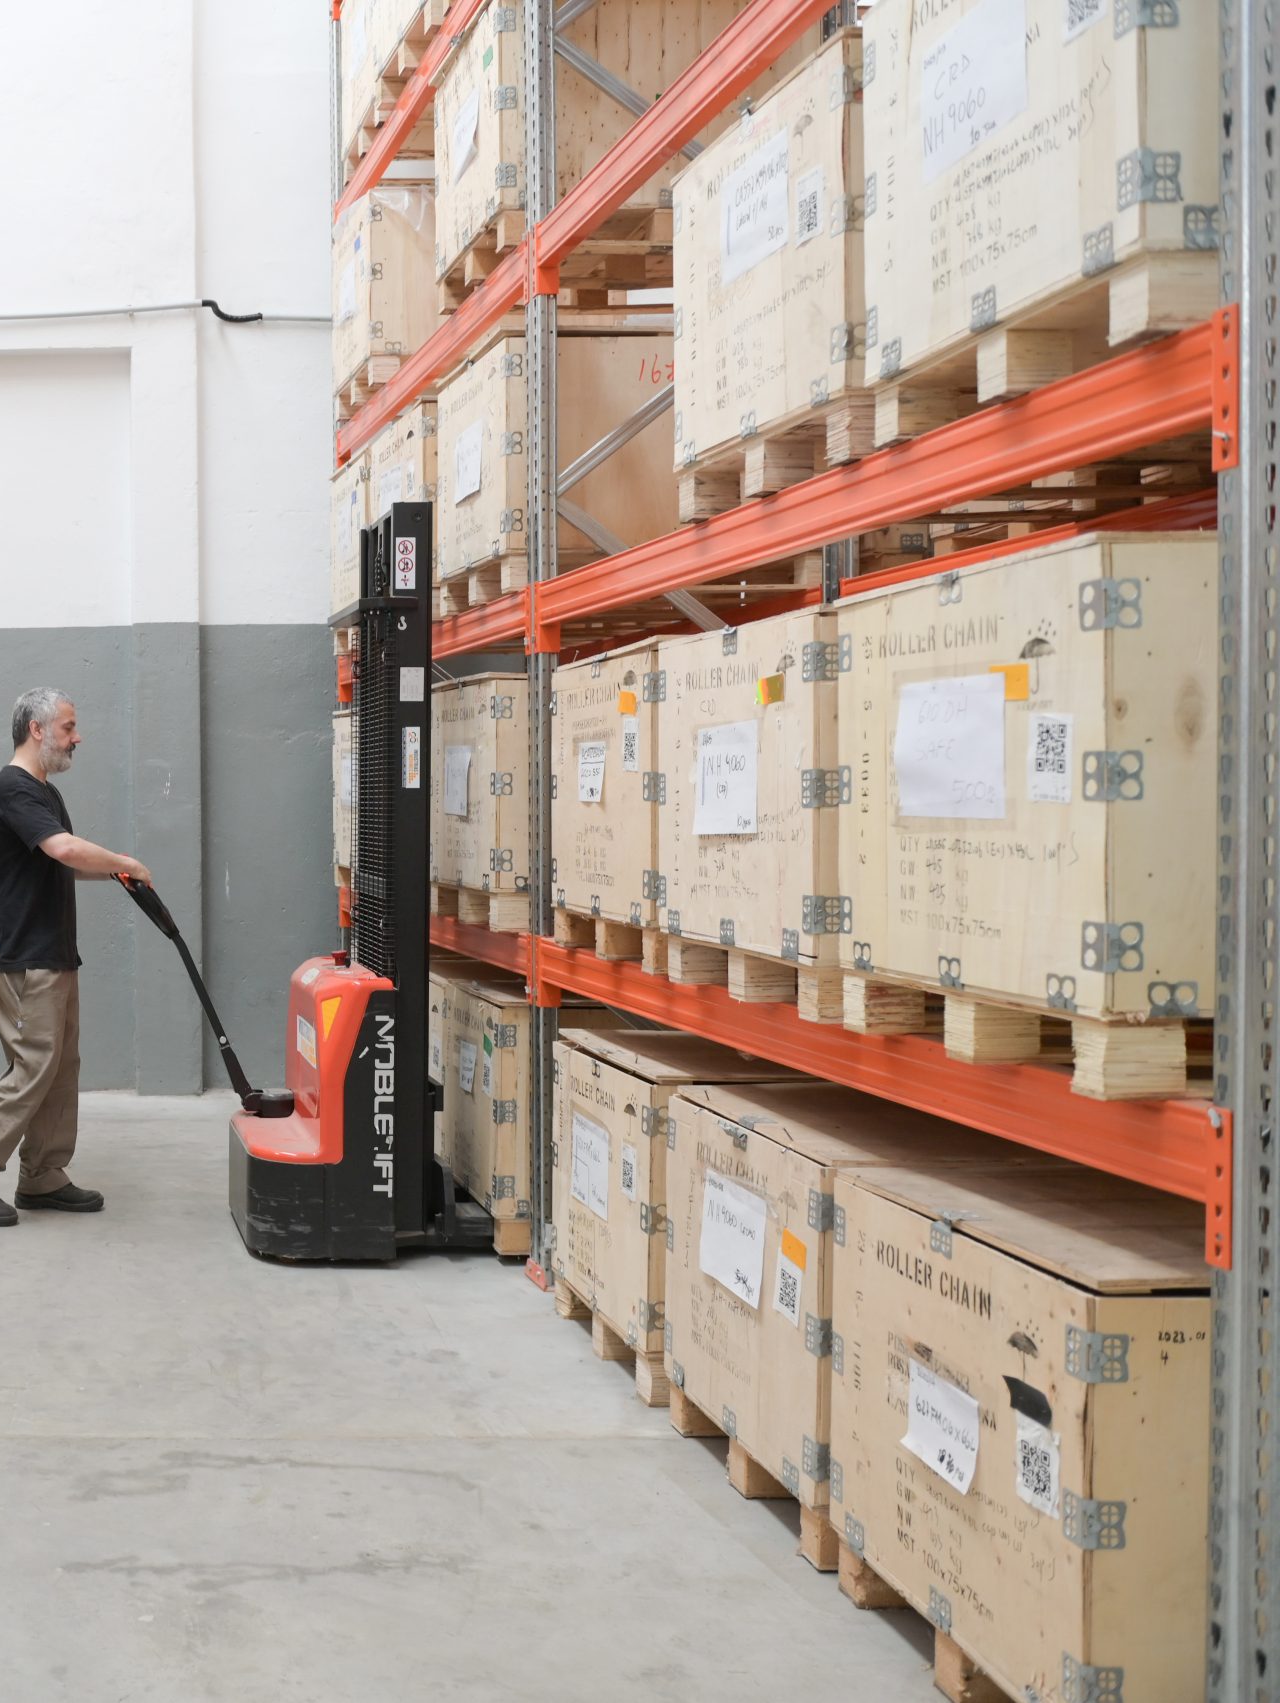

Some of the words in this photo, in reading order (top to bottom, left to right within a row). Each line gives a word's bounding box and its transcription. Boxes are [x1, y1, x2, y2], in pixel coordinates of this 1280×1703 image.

[934, 53, 971, 101] CRD
[879, 624, 936, 659] ROLLER
[942, 613, 999, 650] CHAIN
[686, 666, 722, 691] ROLLER
[726, 662, 760, 688] CHAIN
[900, 836, 920, 852] QTY
[372, 1014, 395, 1198] NOBLEIFT
[696, 1140, 733, 1176] ROLLER
[876, 1239, 933, 1291] ROLLER
[939, 1270, 992, 1321] CHAIN
[896, 1456, 915, 1485] QTY
[896, 1527, 916, 1554] MST
